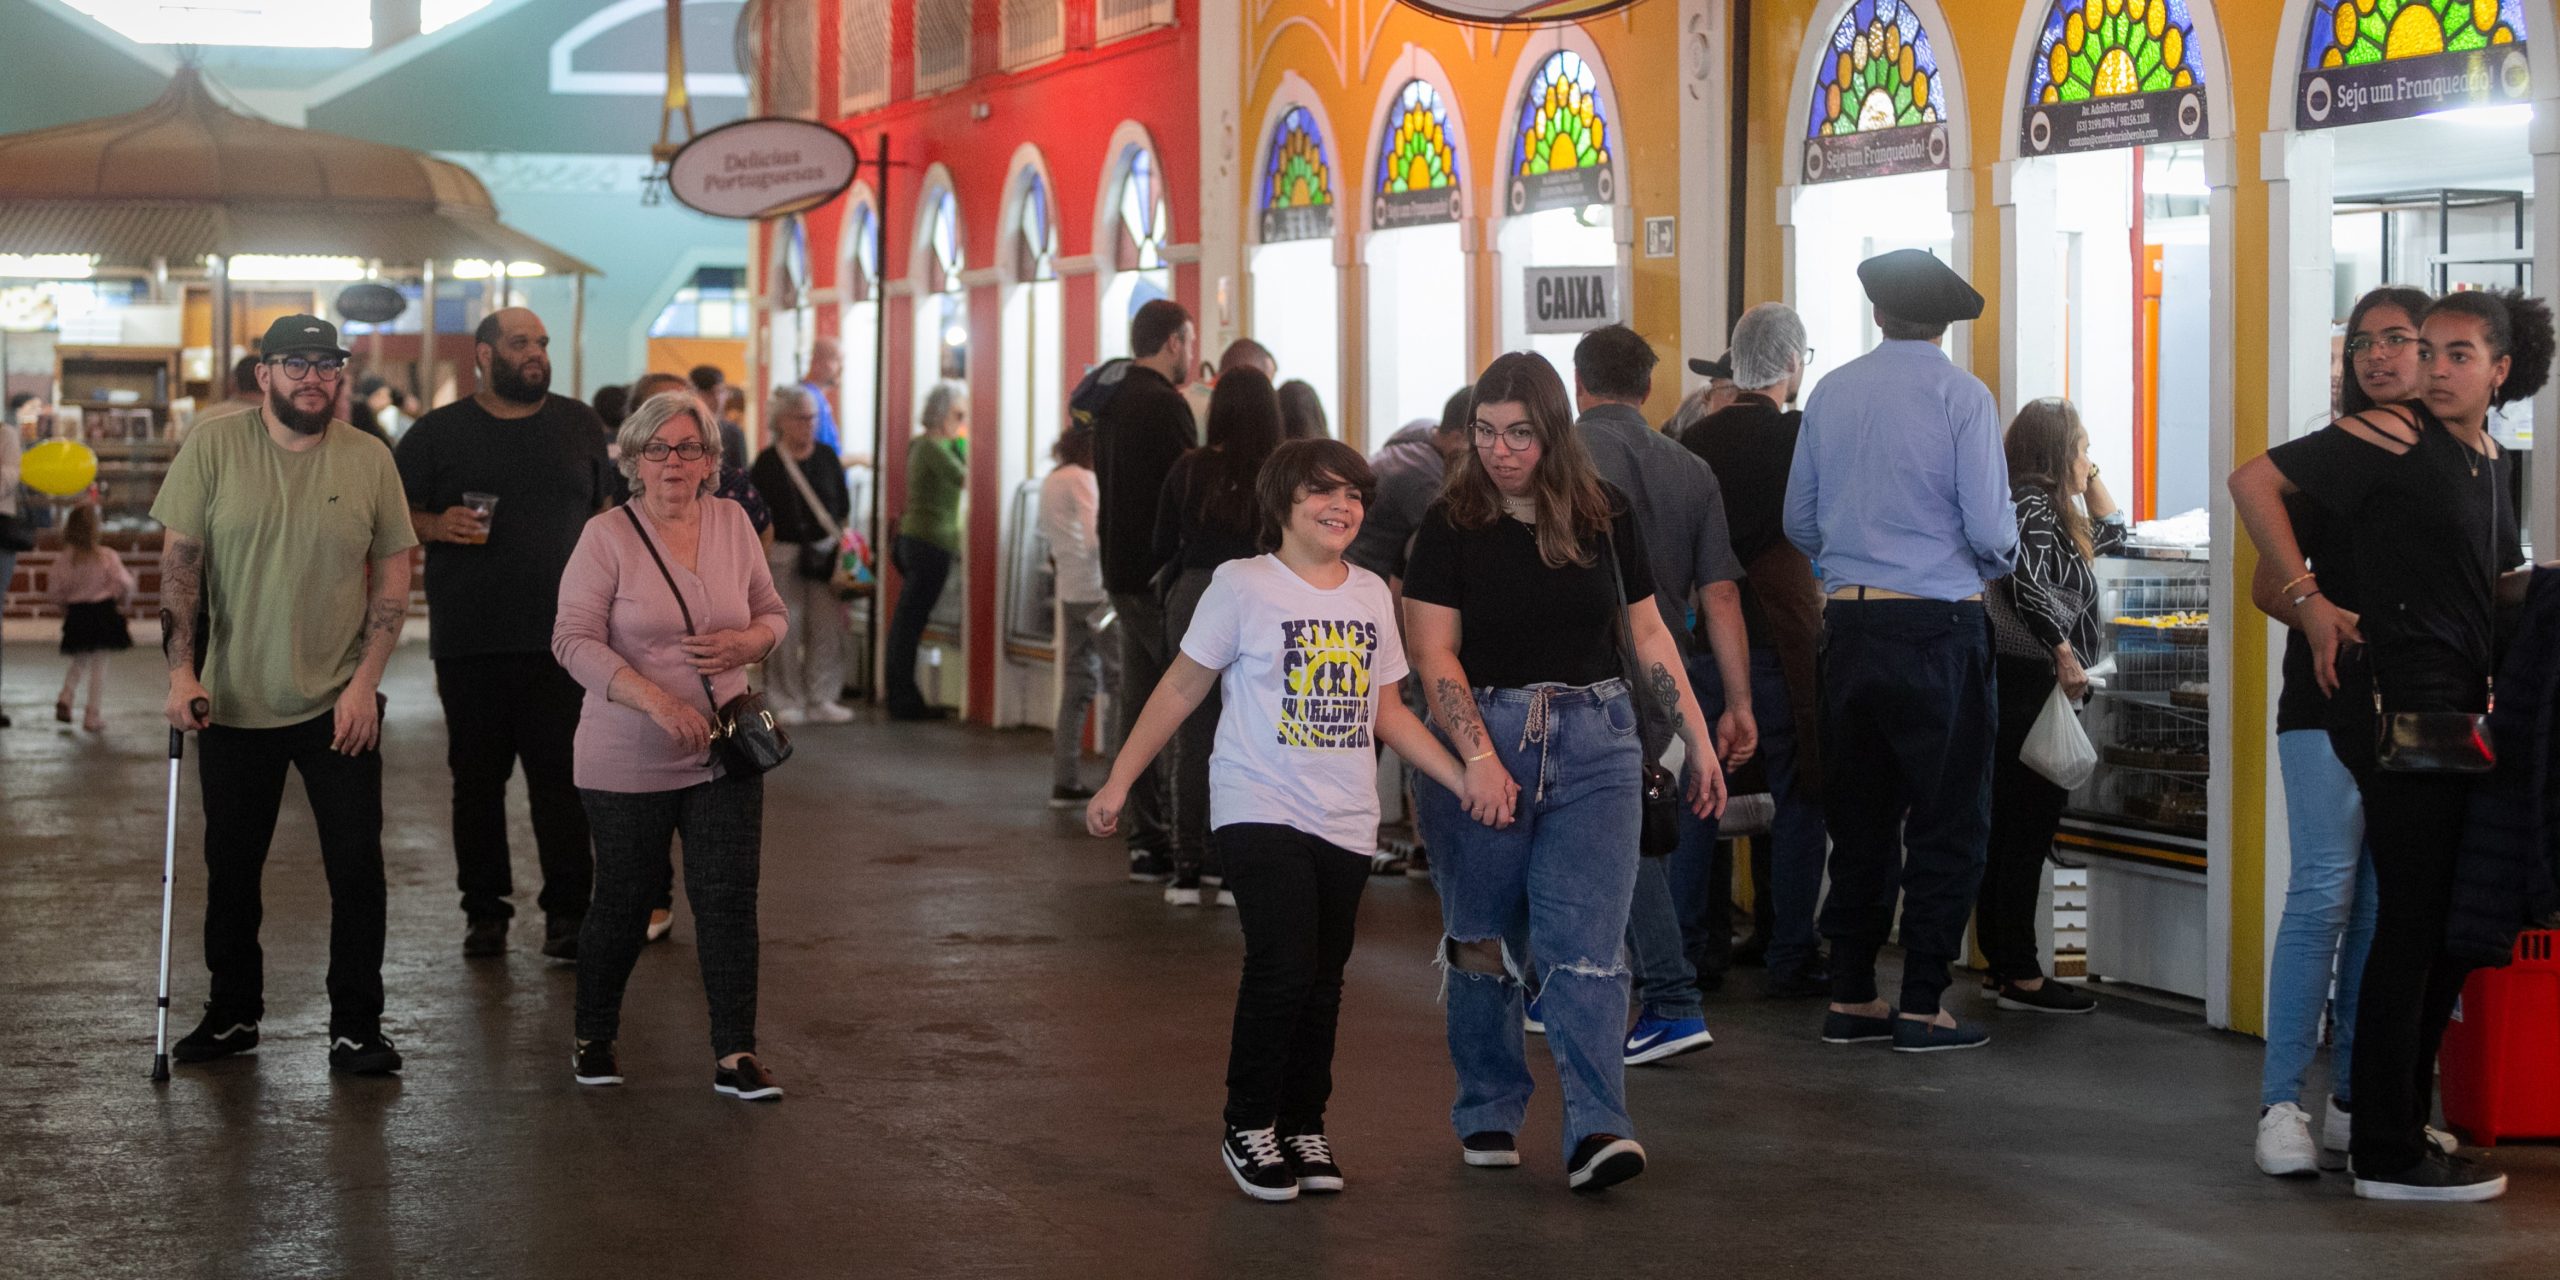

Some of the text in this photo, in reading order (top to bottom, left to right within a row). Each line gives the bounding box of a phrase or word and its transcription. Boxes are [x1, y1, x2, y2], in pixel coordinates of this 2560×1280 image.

[2090, 102, 2110, 115] Adolfo
[2337, 82, 2368, 112] Seja
[2370, 86, 2394, 104] um
[1826, 138, 1925, 173] Seja um Franqueado!
[1536, 275, 1607, 321] CAIXA
[1281, 619, 1377, 651] KINGS
